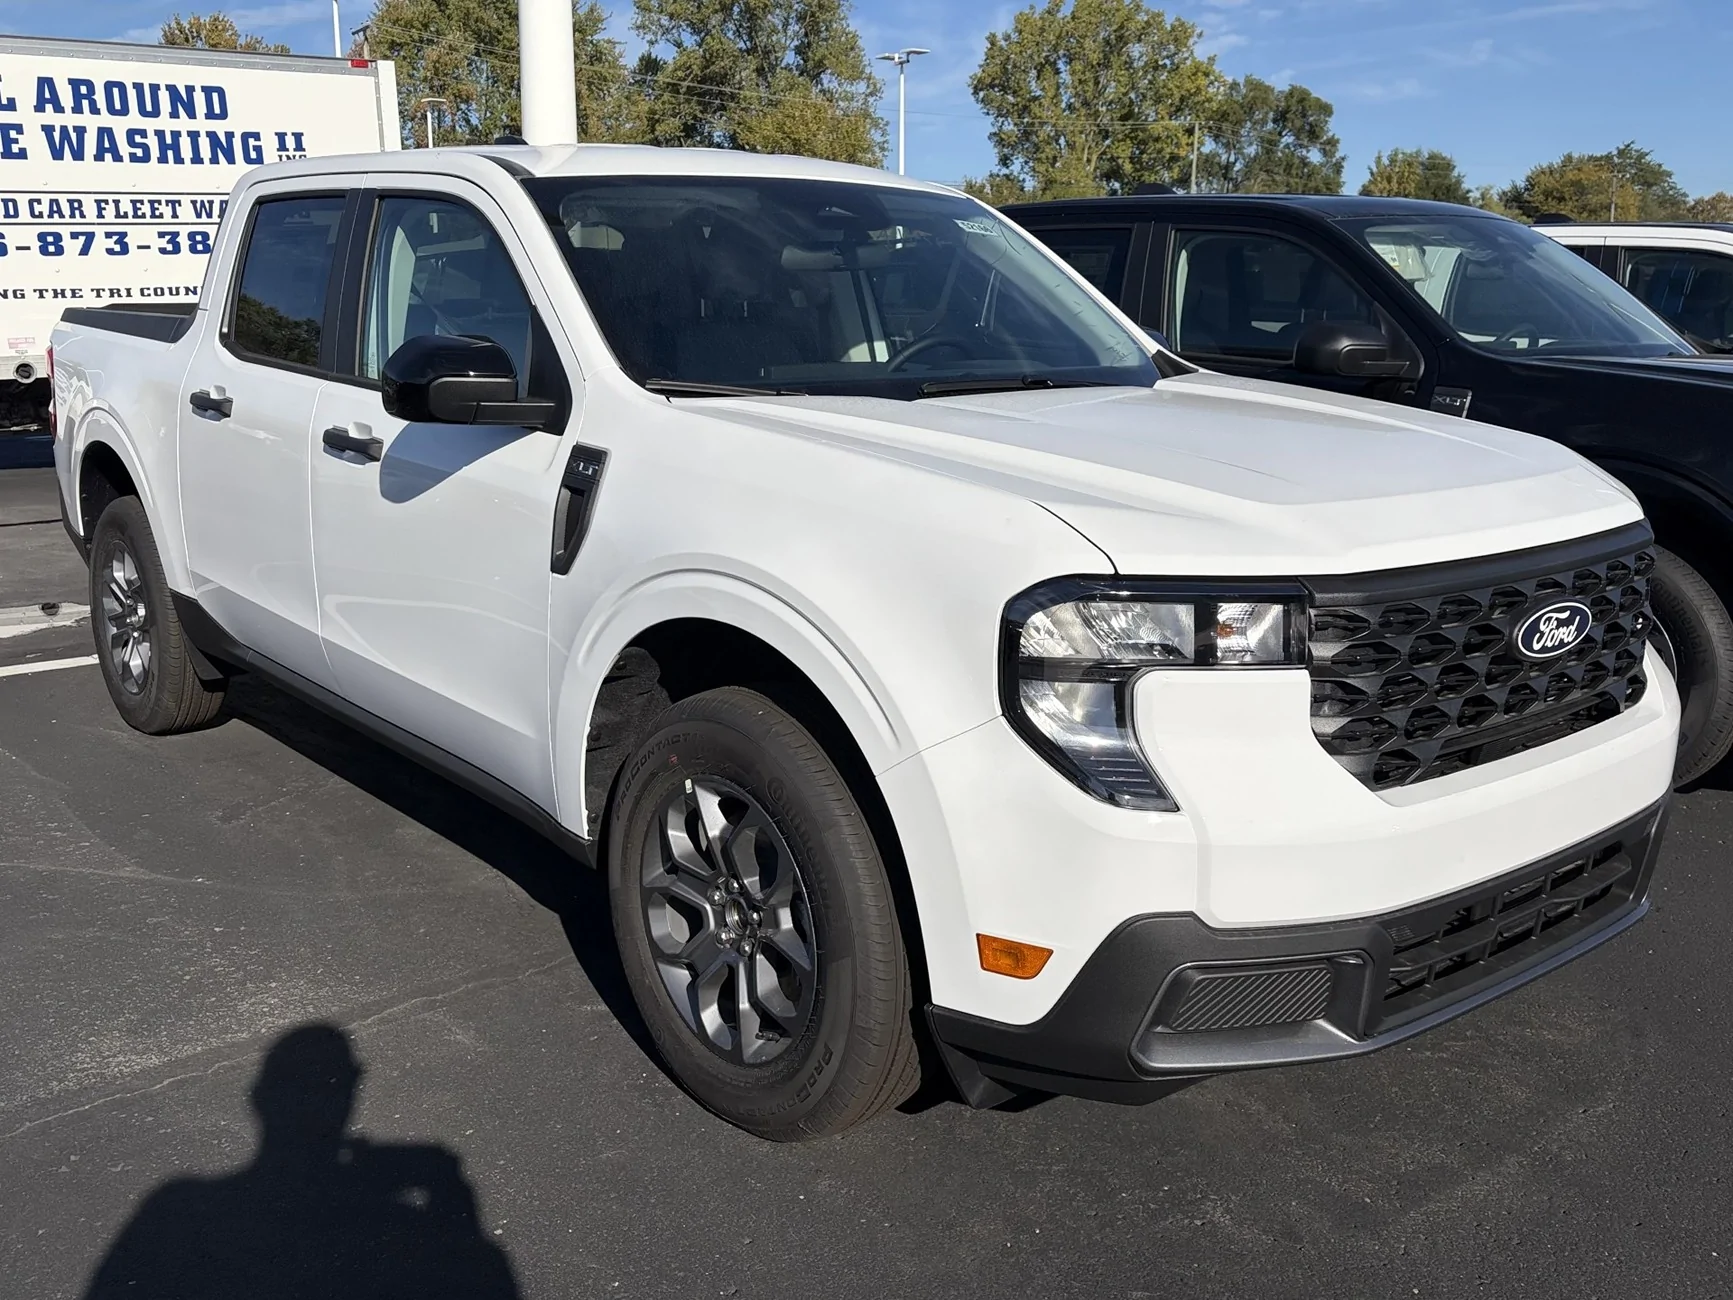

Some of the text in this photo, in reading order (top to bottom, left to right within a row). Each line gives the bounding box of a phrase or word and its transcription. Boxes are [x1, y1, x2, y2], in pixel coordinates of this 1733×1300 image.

[33, 76, 229, 121] AROUND
[40, 123, 265, 166] WASHING
[28, 198, 87, 219] CAR
[93, 198, 182, 219] FLEET
[33, 288, 84, 299] THE
[90, 287, 133, 298] TRI
[139, 285, 203, 297] COUN
[1532, 609, 1581, 651] Ford
